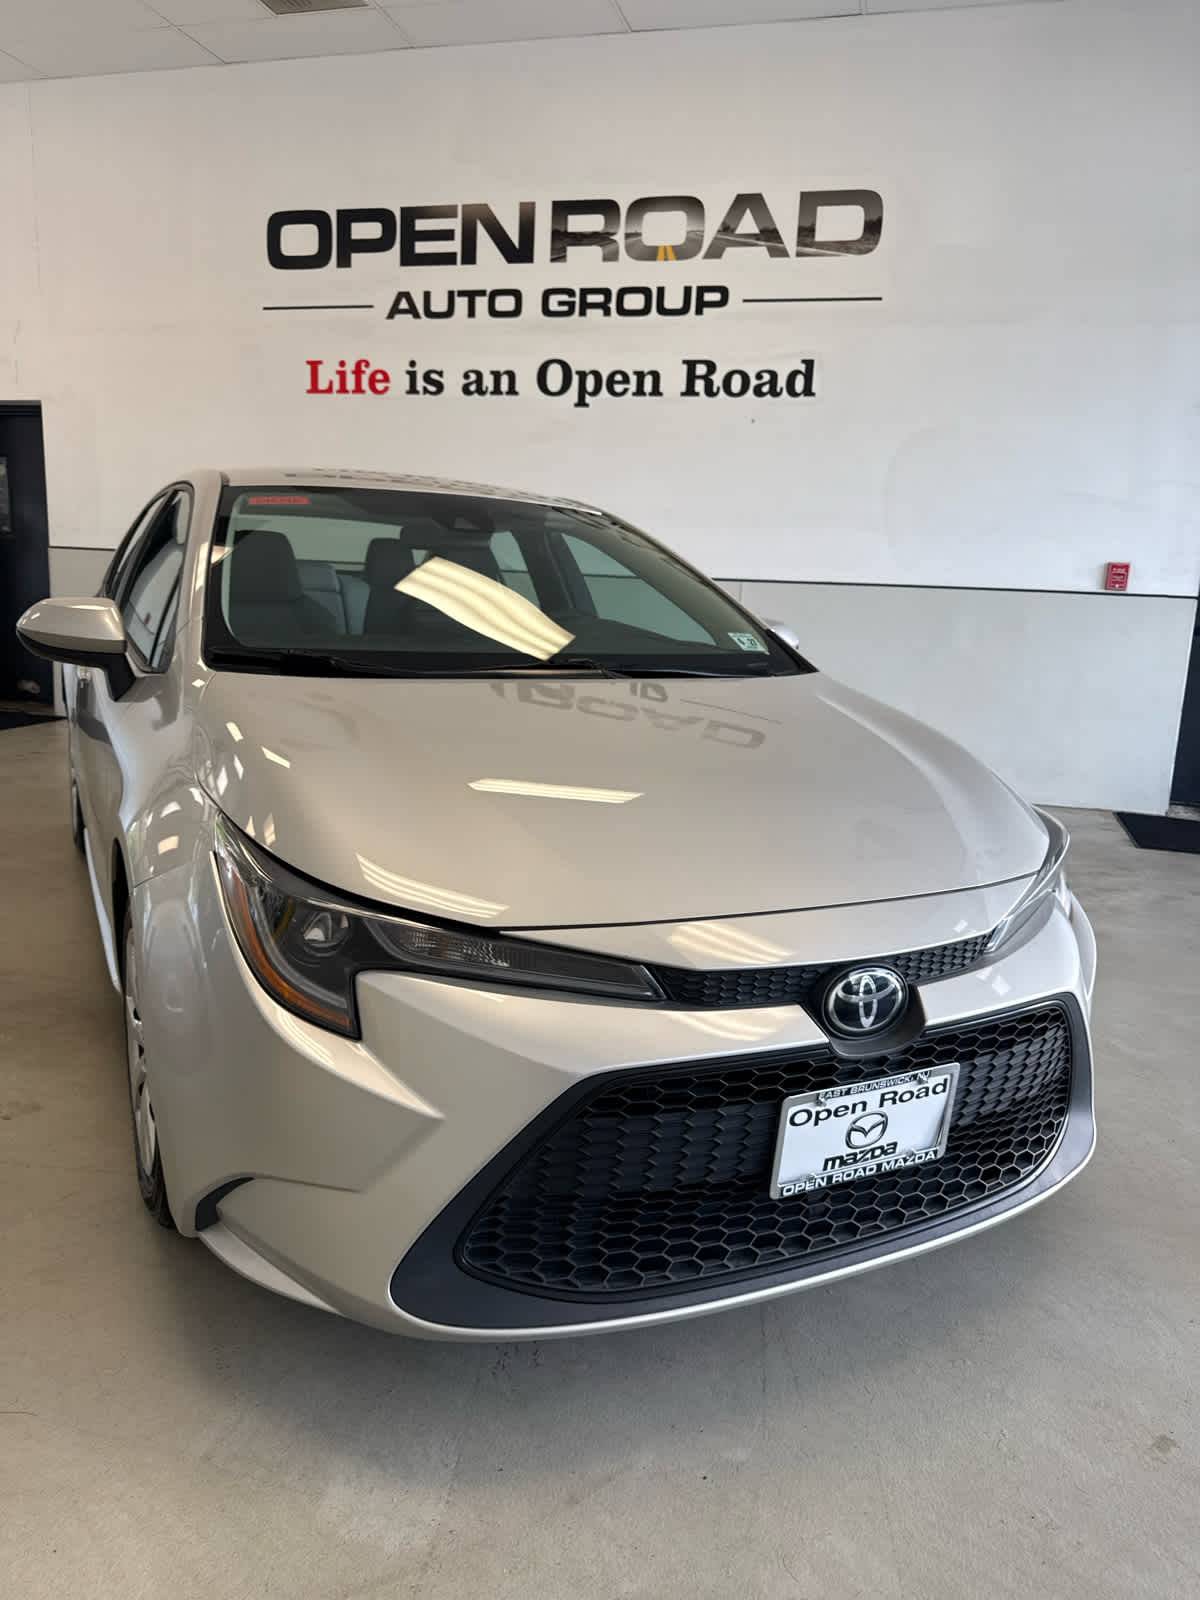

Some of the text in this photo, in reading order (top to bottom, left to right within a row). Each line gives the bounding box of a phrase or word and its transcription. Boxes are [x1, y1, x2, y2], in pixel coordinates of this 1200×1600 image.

[266, 189, 883, 270] OPEN ROAD
[385, 285, 730, 320] AUTO GROUP
[306, 358, 816, 408] Life is an Open Road
[789, 1078, 949, 1127] Open Road
[818, 1088, 848, 1101] EAST
[782, 1150, 936, 1197] OPEN ROAD MAZDA
